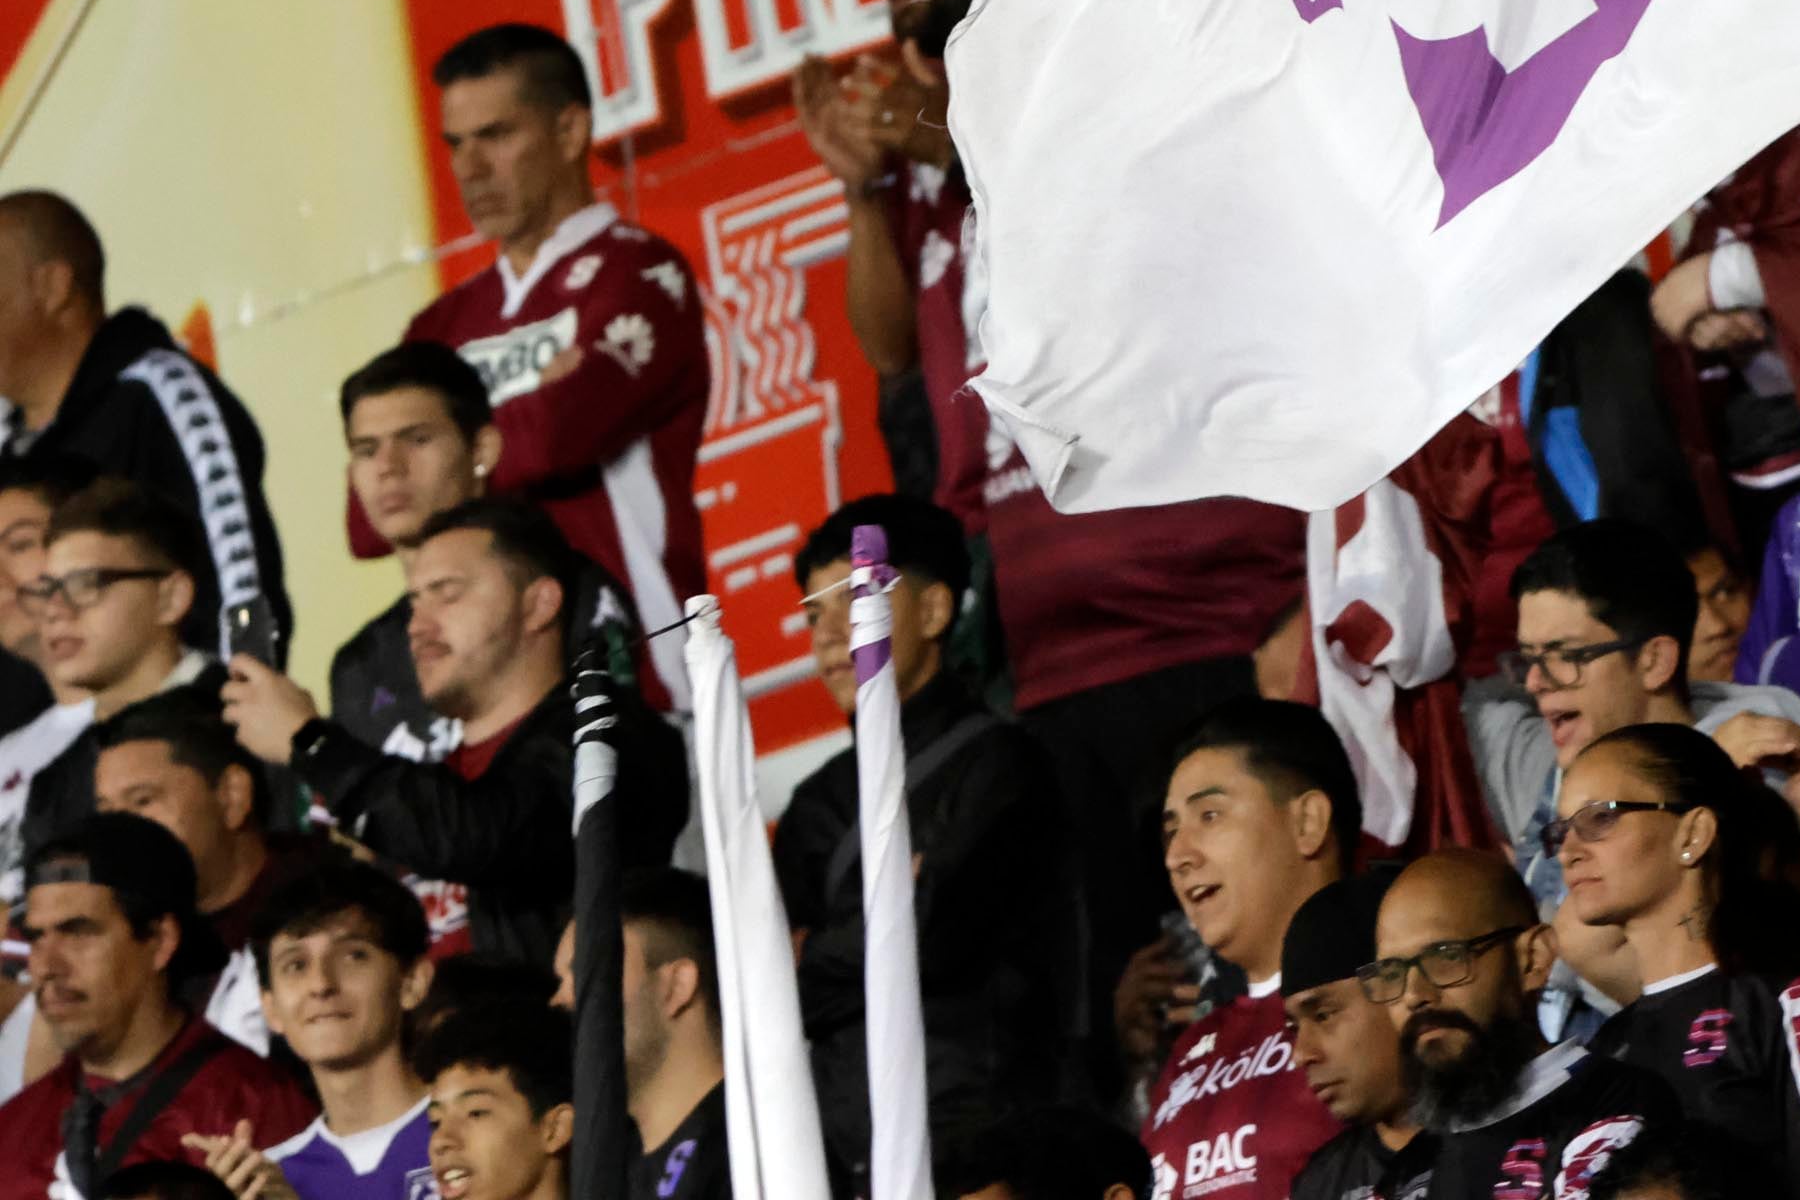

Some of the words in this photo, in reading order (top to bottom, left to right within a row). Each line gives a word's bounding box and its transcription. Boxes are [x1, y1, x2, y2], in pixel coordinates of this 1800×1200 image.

[1681, 1007, 1734, 1069] S
[656, 1138, 698, 1200] S
[1183, 1123, 1258, 1187] BAC
